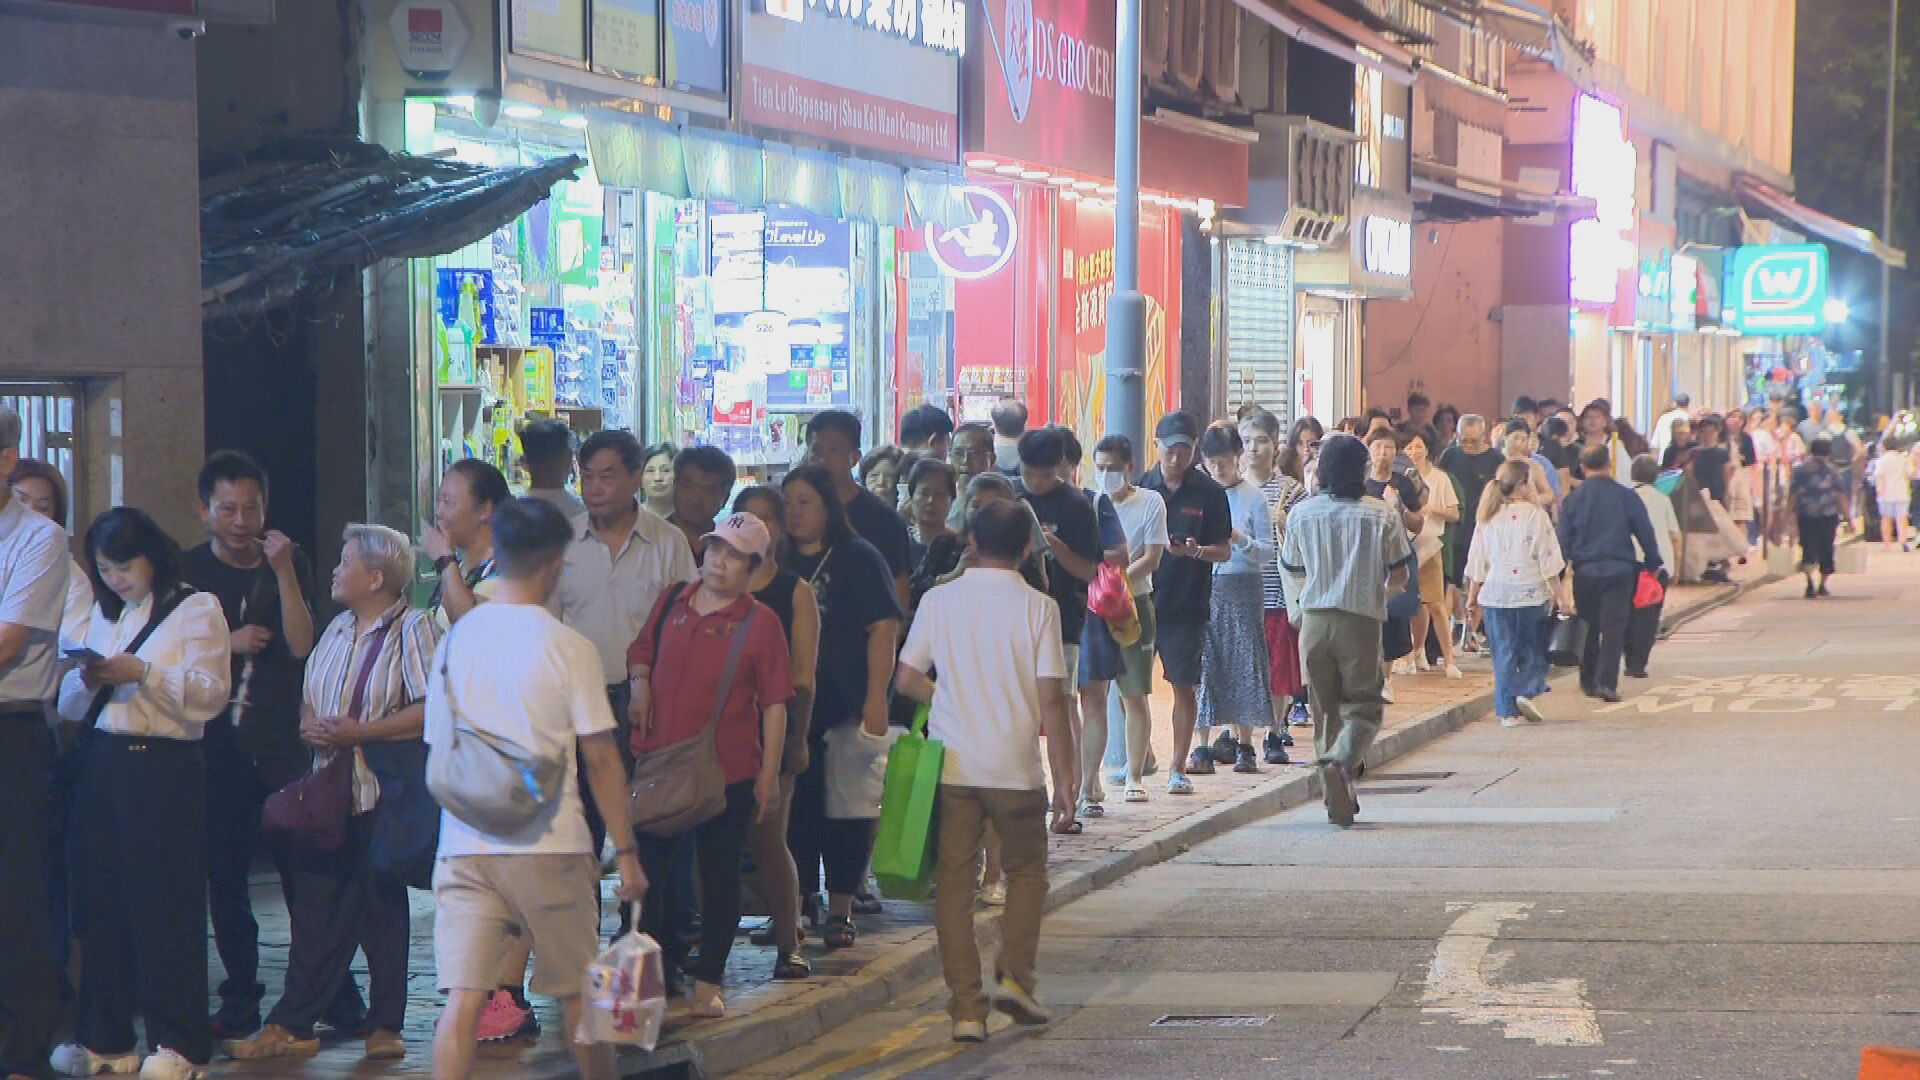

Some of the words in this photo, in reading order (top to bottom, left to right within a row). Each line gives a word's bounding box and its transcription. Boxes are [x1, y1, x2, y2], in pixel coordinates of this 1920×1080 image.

[1035, 16, 1054, 81] DS
[752, 76, 774, 109] Tien
[775, 81, 786, 113] Lu
[788, 85, 838, 130] Dispensary
[839, 96, 862, 129] (Shau
[863, 103, 877, 133] Kei
[878, 106, 898, 140] Wan)
[900, 112, 934, 152] Company
[775, 228, 806, 243] Level
[808, 229, 826, 246] Up
